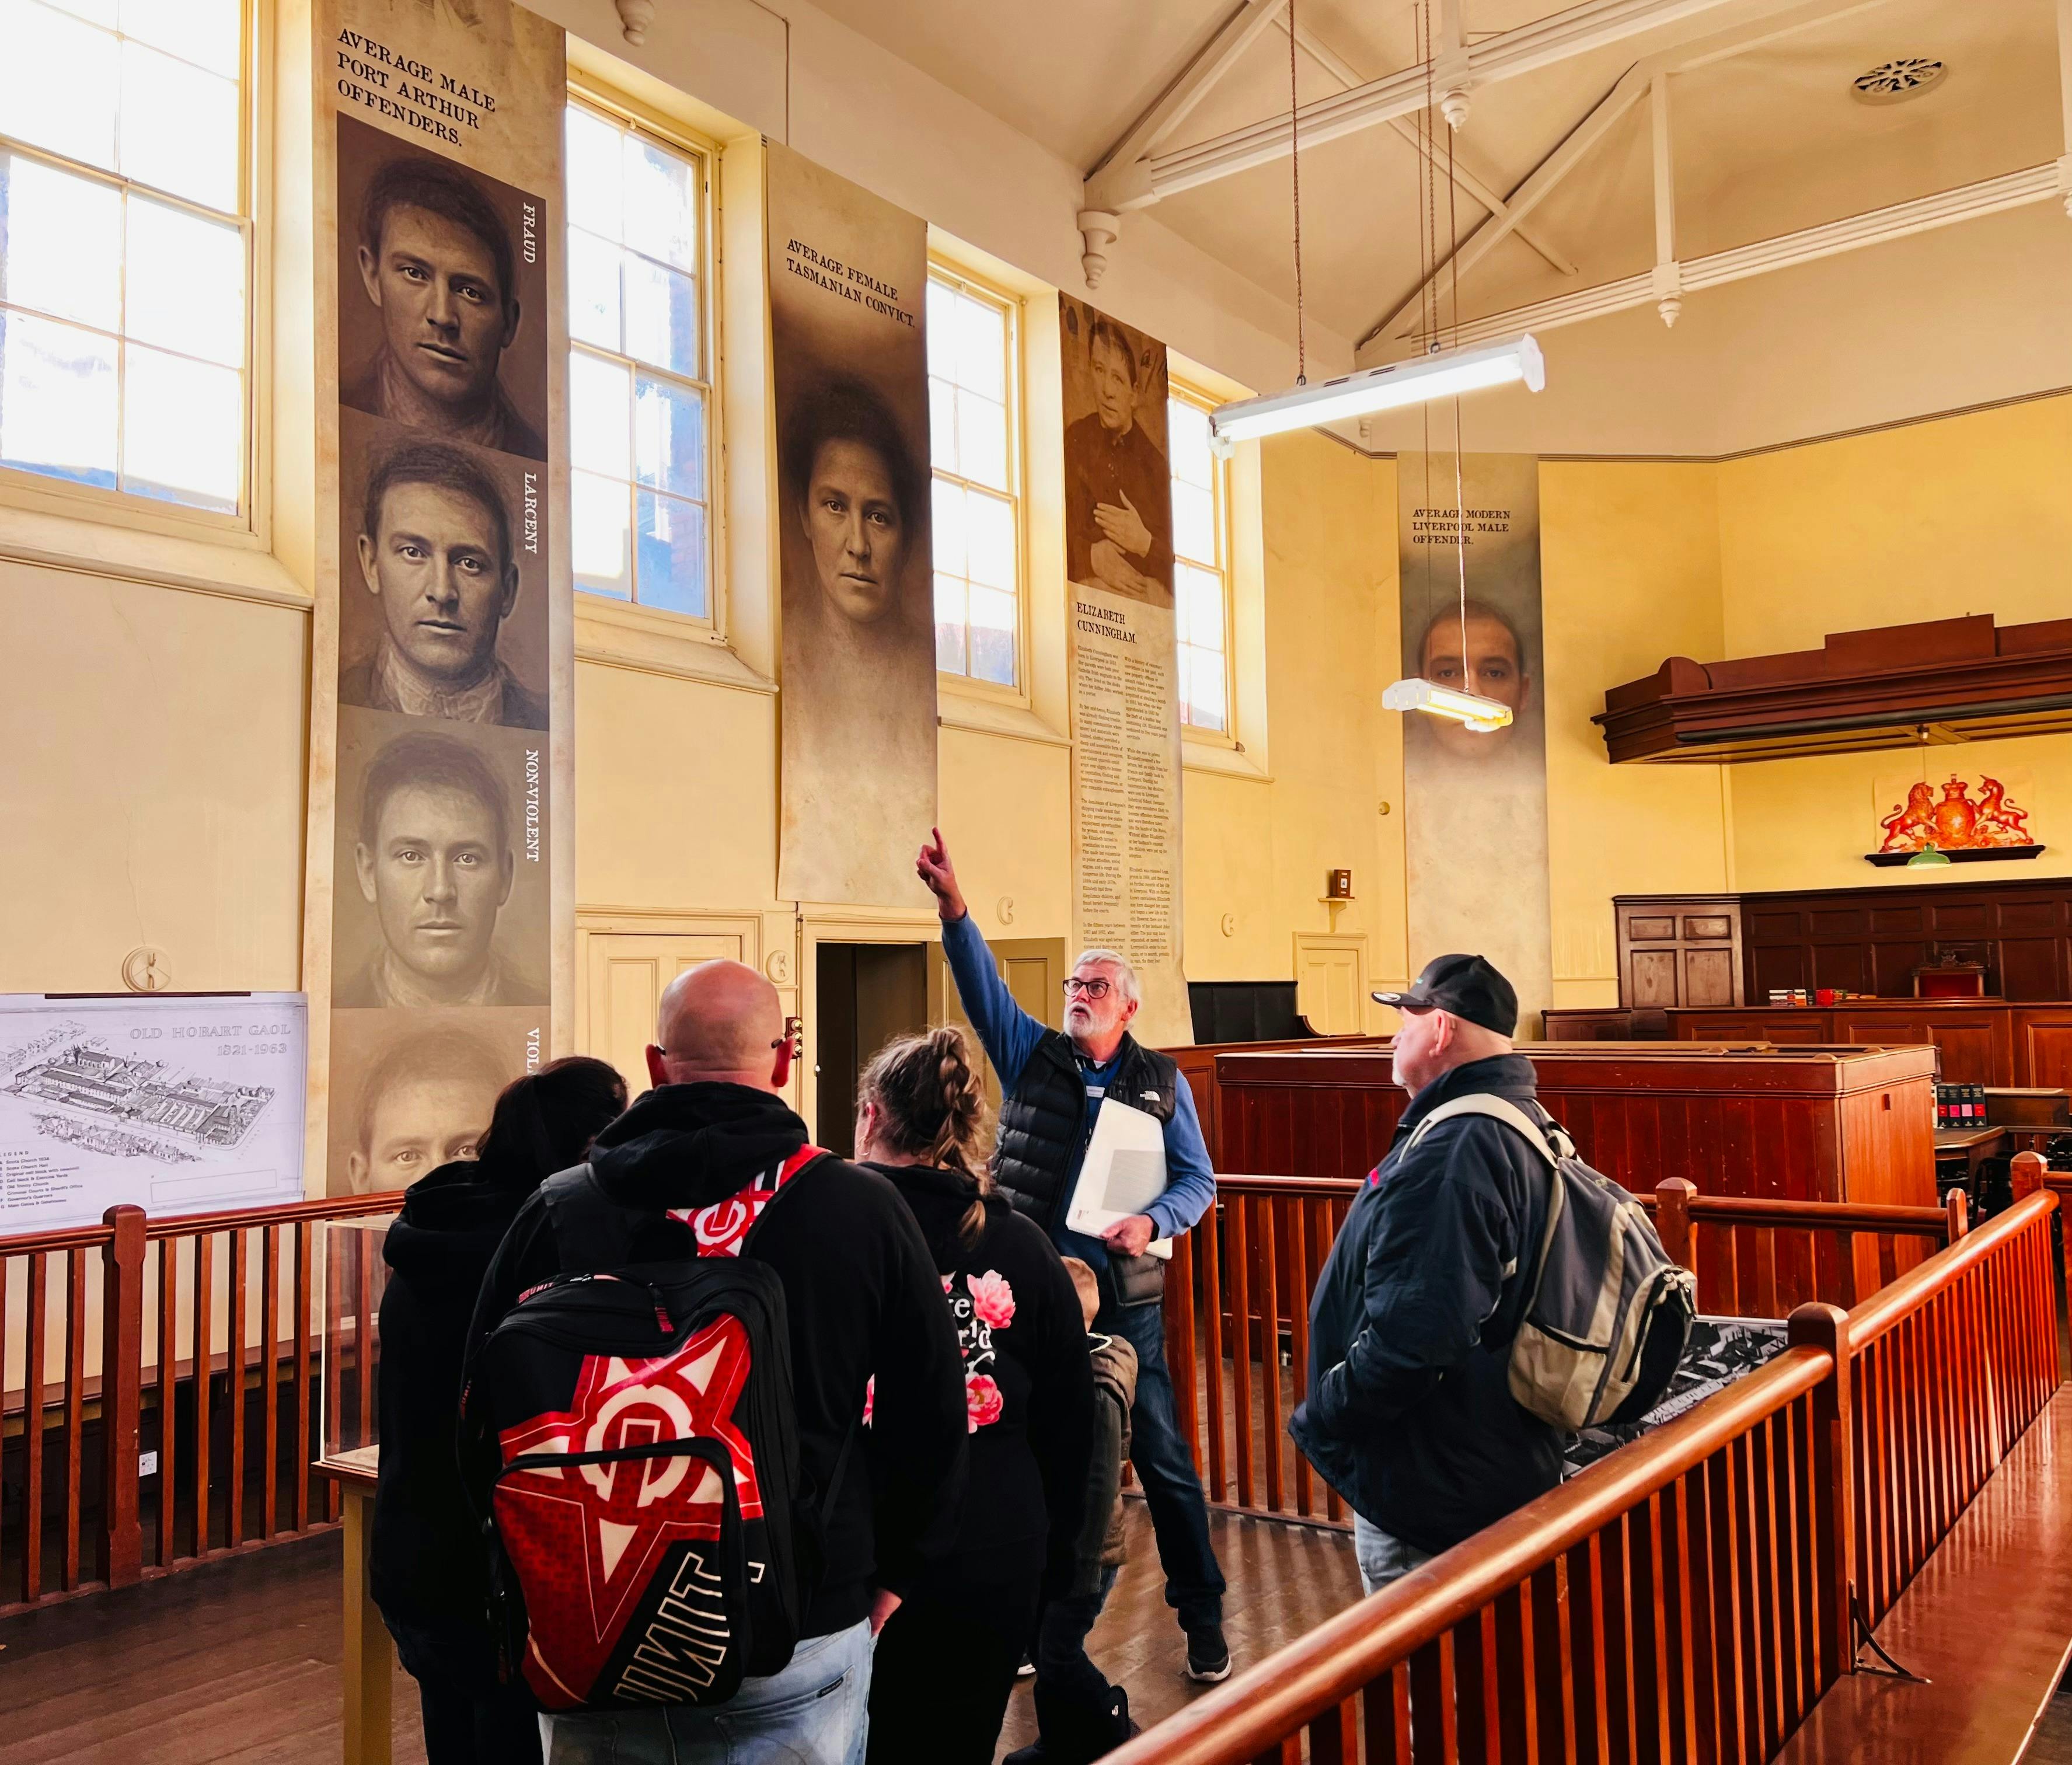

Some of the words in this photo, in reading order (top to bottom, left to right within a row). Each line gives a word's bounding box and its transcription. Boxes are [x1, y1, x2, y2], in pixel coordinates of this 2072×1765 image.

[337, 28, 433, 83] AVERAGE
[440, 73, 496, 113] MALE
[337, 51, 389, 88] PORT
[397, 82, 479, 129] ARTHUR
[337, 79, 462, 146] OFFENDERS.
[523, 202, 536, 264] FRAUD
[787, 238, 843, 275] AVERAGE
[847, 267, 898, 301] FEMALE
[787, 257, 861, 304] TASMANIAN
[866, 295, 915, 328] CONVICT.
[525, 472, 537, 554] LARCENY
[1412, 522, 1474, 531] LIVERPOOL
[1477, 524, 1509, 532] MALE
[1466, 510, 1511, 519] MODERN
[1077, 602, 1125, 625] ELIZABETH
[1077, 620, 1137, 644] CUNNINGHAM.
[526, 749, 539, 861] NON-VIOLENT
[130, 1028, 162, 1040] OLD
[172, 1026, 242, 1038] HOBART
[249, 1024, 291, 1035] GAOL
[217, 1043, 287, 1056] 1821-1963
[526, 1027, 539, 1075] VIOL
[613, 1551, 765, 1702] UNIT
